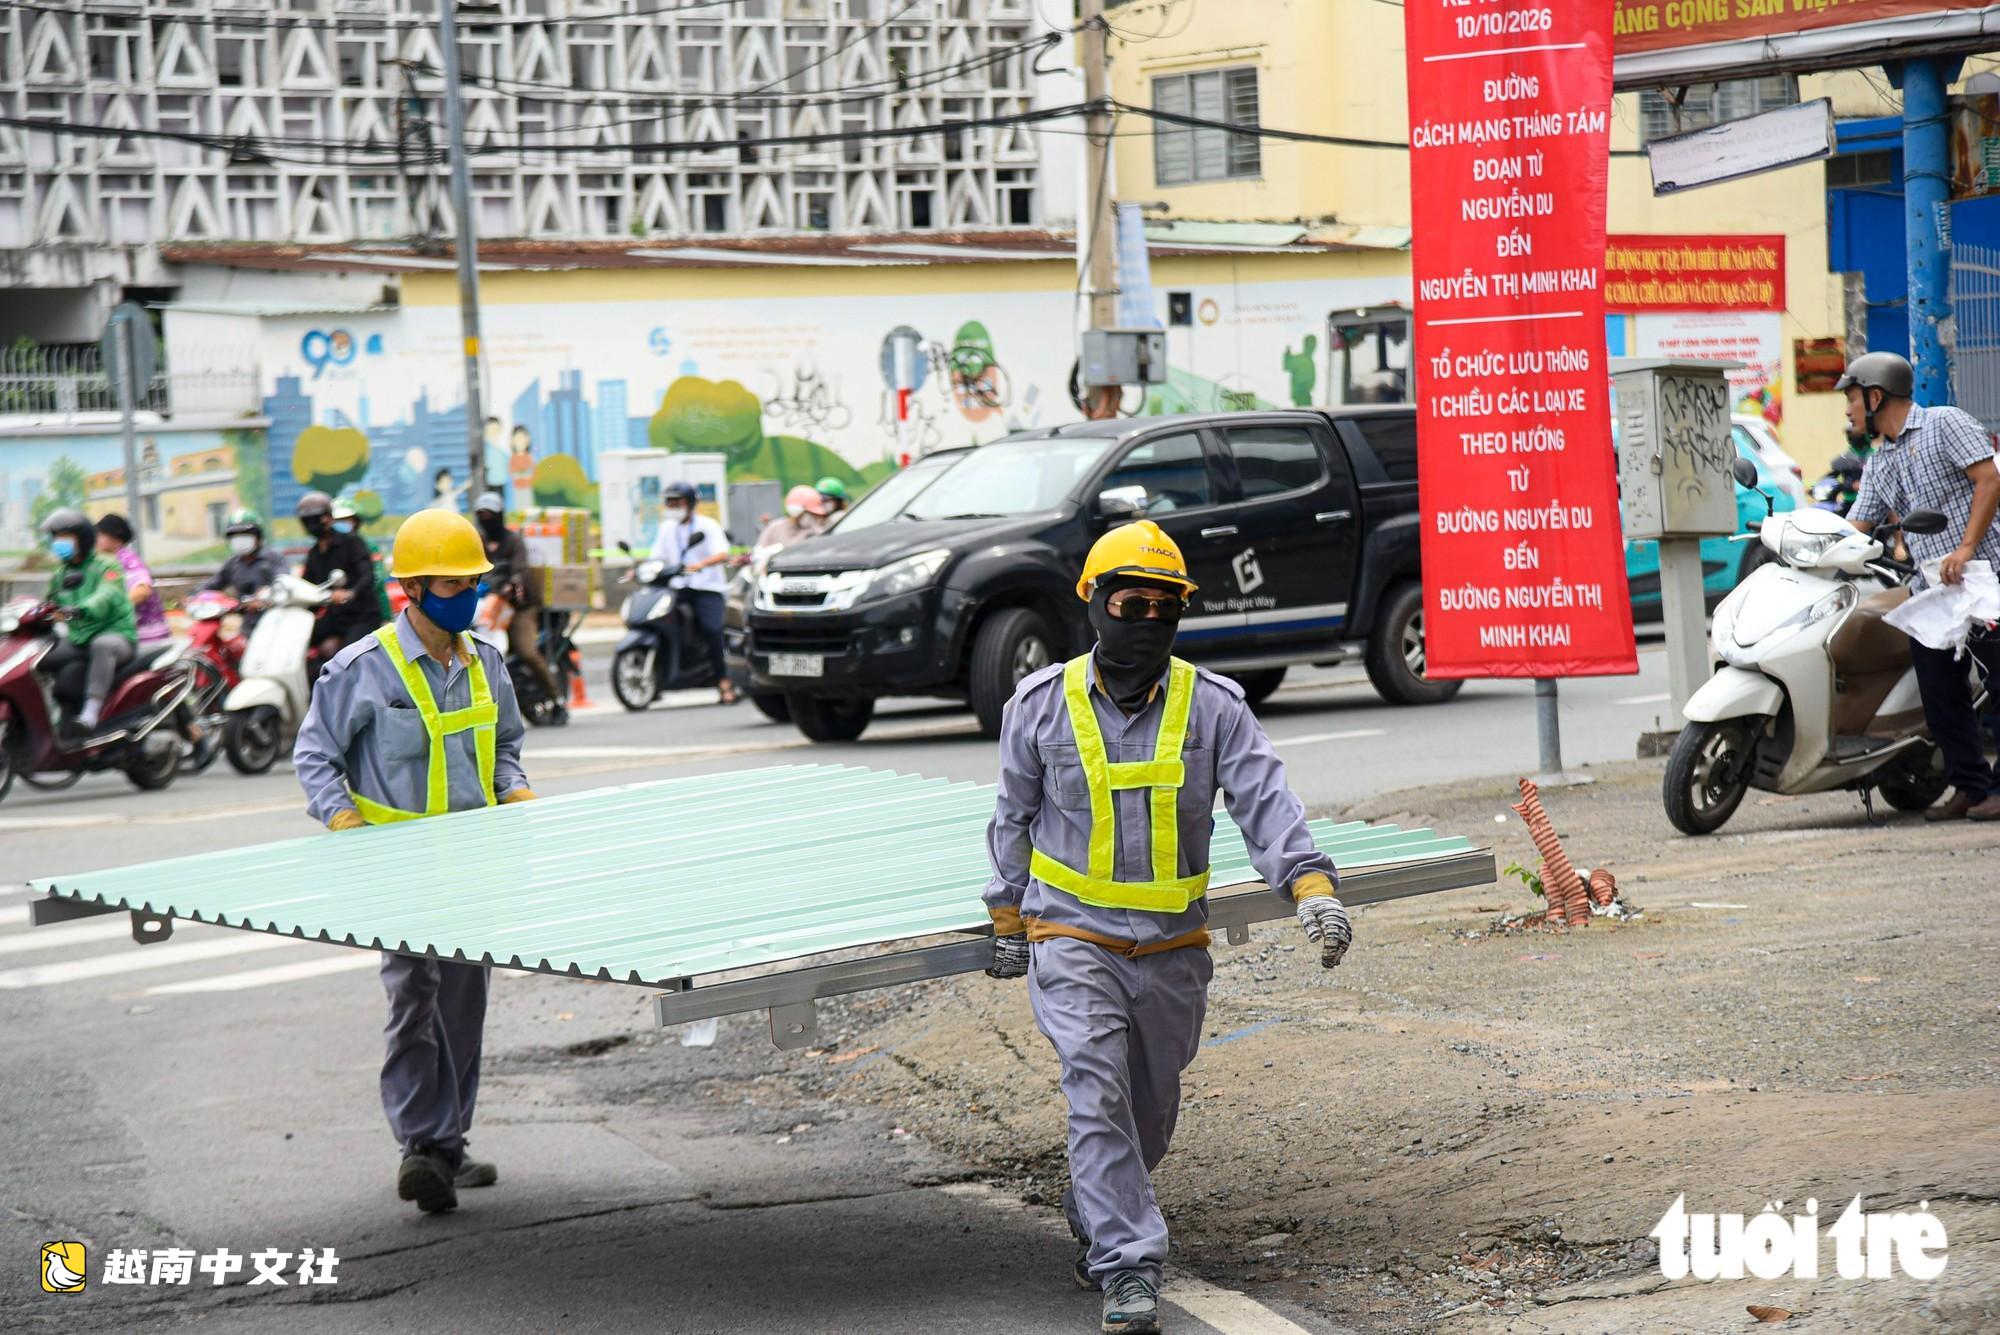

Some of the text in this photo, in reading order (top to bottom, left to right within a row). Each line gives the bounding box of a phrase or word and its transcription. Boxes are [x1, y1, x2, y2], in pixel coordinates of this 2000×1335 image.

[1456, 8, 1552, 39] 10/10/2026
[1612, 2, 1659, 35] ẢNG
[1483, 72, 1539, 103] ĐƯỜNG
[1413, 105, 1606, 149] CÁCH MẠNG THÁNG TÁM
[1472, 149, 1544, 185] ĐOẠN TỪ
[1461, 187, 1553, 221] NGUYỄN DU
[1496, 226, 1532, 258] ĐẾN
[1420, 267, 1597, 301] NGUYỄN THỊ MINH KHAI
[1430, 345, 1589, 379] TỔ CHỨC LƯU THÔNG
[1431, 386, 1586, 418] 1 CHIỀU CÁC LOẠI XE
[1459, 424, 1565, 455] THEO HƯỚNG
[1506, 464, 1530, 492] TỪ
[1436, 499, 1593, 534] ĐƯỜNG NGUYỄN DU
[1503, 540, 1539, 570] ĐẾN
[1202, 595, 1277, 612] Your Right Way
[1439, 576, 1602, 611] ĐƯỜNG NGUYỄN THỊ
[1479, 623, 1571, 648] MINH KHAI
